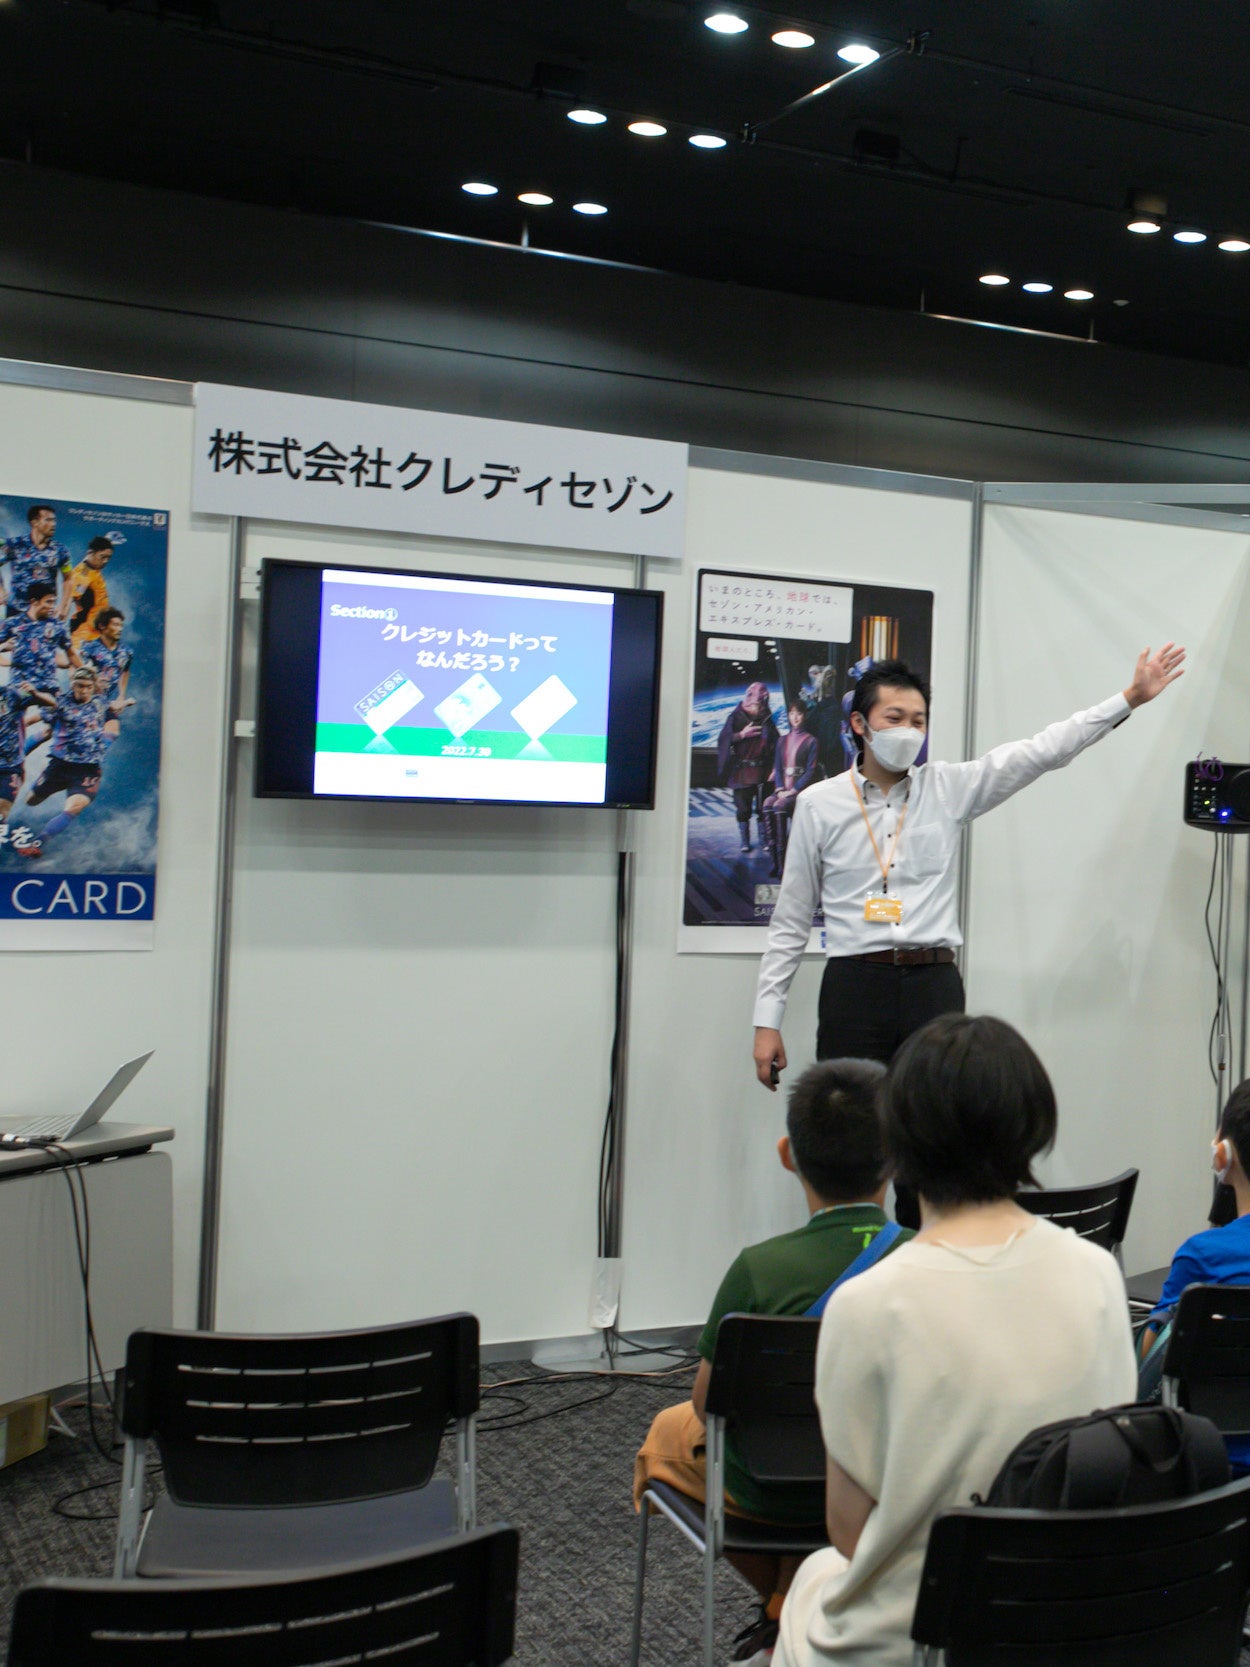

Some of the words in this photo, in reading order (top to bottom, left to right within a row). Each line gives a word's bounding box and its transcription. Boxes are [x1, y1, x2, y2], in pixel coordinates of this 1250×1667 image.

[208, 428, 673, 515] 株式会社クレディセゾン
[381, 623, 558, 652] クレジットカードって
[359, 672, 404, 713] SAISON
[11, 879, 147, 914] CARD
